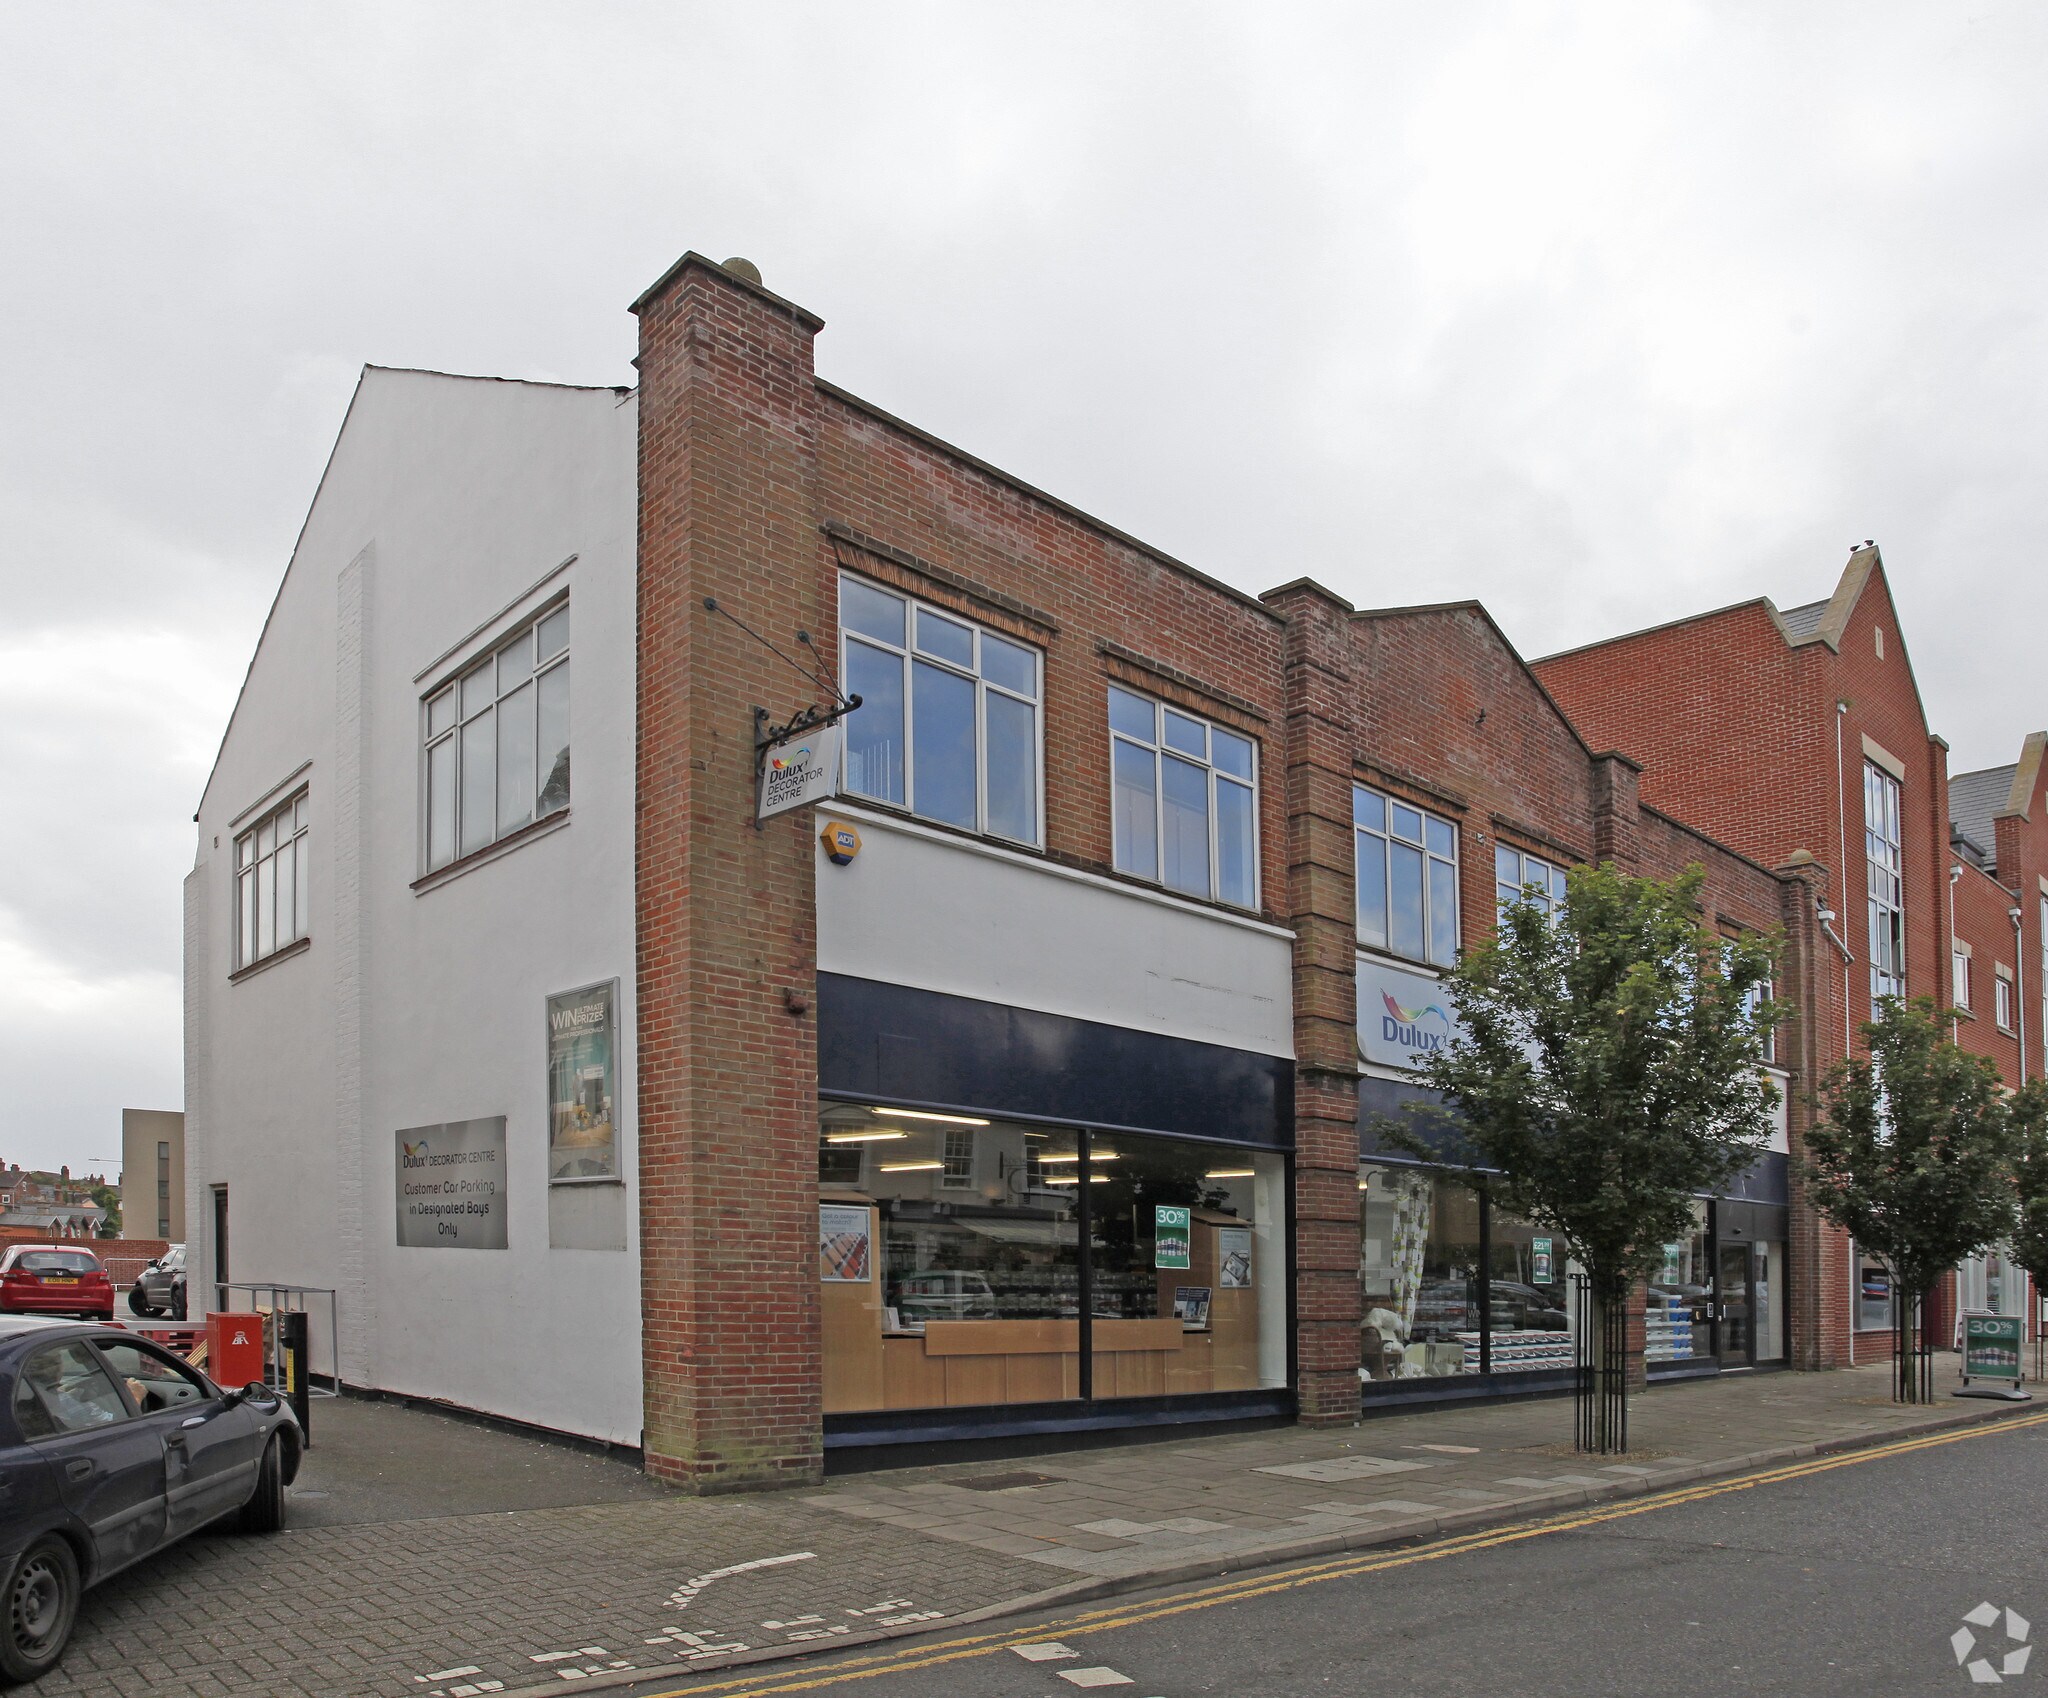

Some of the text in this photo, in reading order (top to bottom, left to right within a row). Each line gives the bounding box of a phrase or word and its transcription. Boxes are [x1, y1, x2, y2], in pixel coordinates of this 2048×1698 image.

[767, 767, 823, 796] DECORATOR
[769, 763, 804, 785] Dulux
[766, 786, 802, 807] CENTRE
[837, 833, 854, 846] ADT
[552, 1008, 577, 1030] WIN
[577, 1011, 604, 1025] PRIZES
[1382, 1015, 1441, 1051] Dulux
[403, 1150, 495, 1169] Dulux DECORATOR CENTRE
[404, 1179, 495, 1195] Customer Car Parking
[409, 1201, 490, 1218] in Designated Bays
[1157, 1209, 1185, 1224] 30%
[438, 1222, 458, 1238] Only
[1969, 1320, 2013, 1334] 30%
